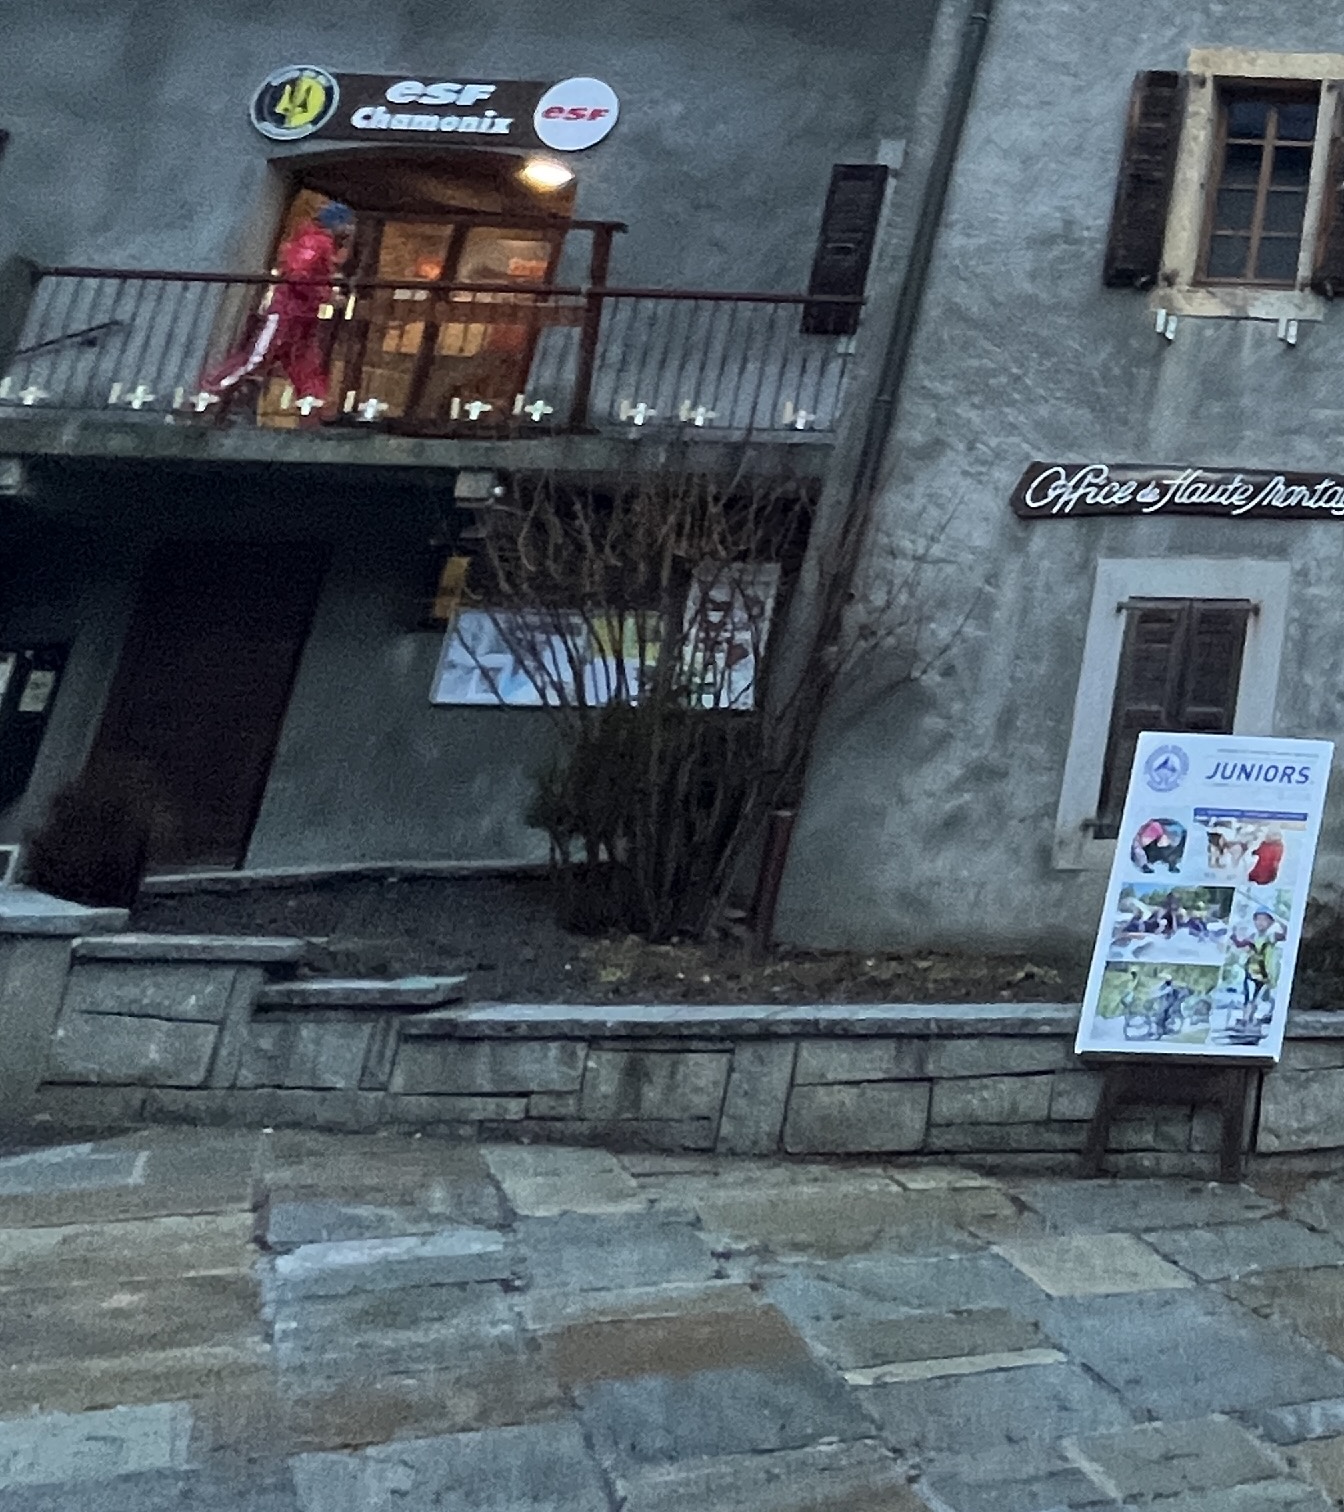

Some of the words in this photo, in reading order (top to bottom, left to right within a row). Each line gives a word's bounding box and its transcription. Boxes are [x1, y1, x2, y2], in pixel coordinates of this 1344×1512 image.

[350, 106, 515, 135] Chamonix
[1024, 464, 1134, 514] Office
[1142, 468, 1252, 513] Haute
[1205, 761, 1312, 785] JUNIORS
